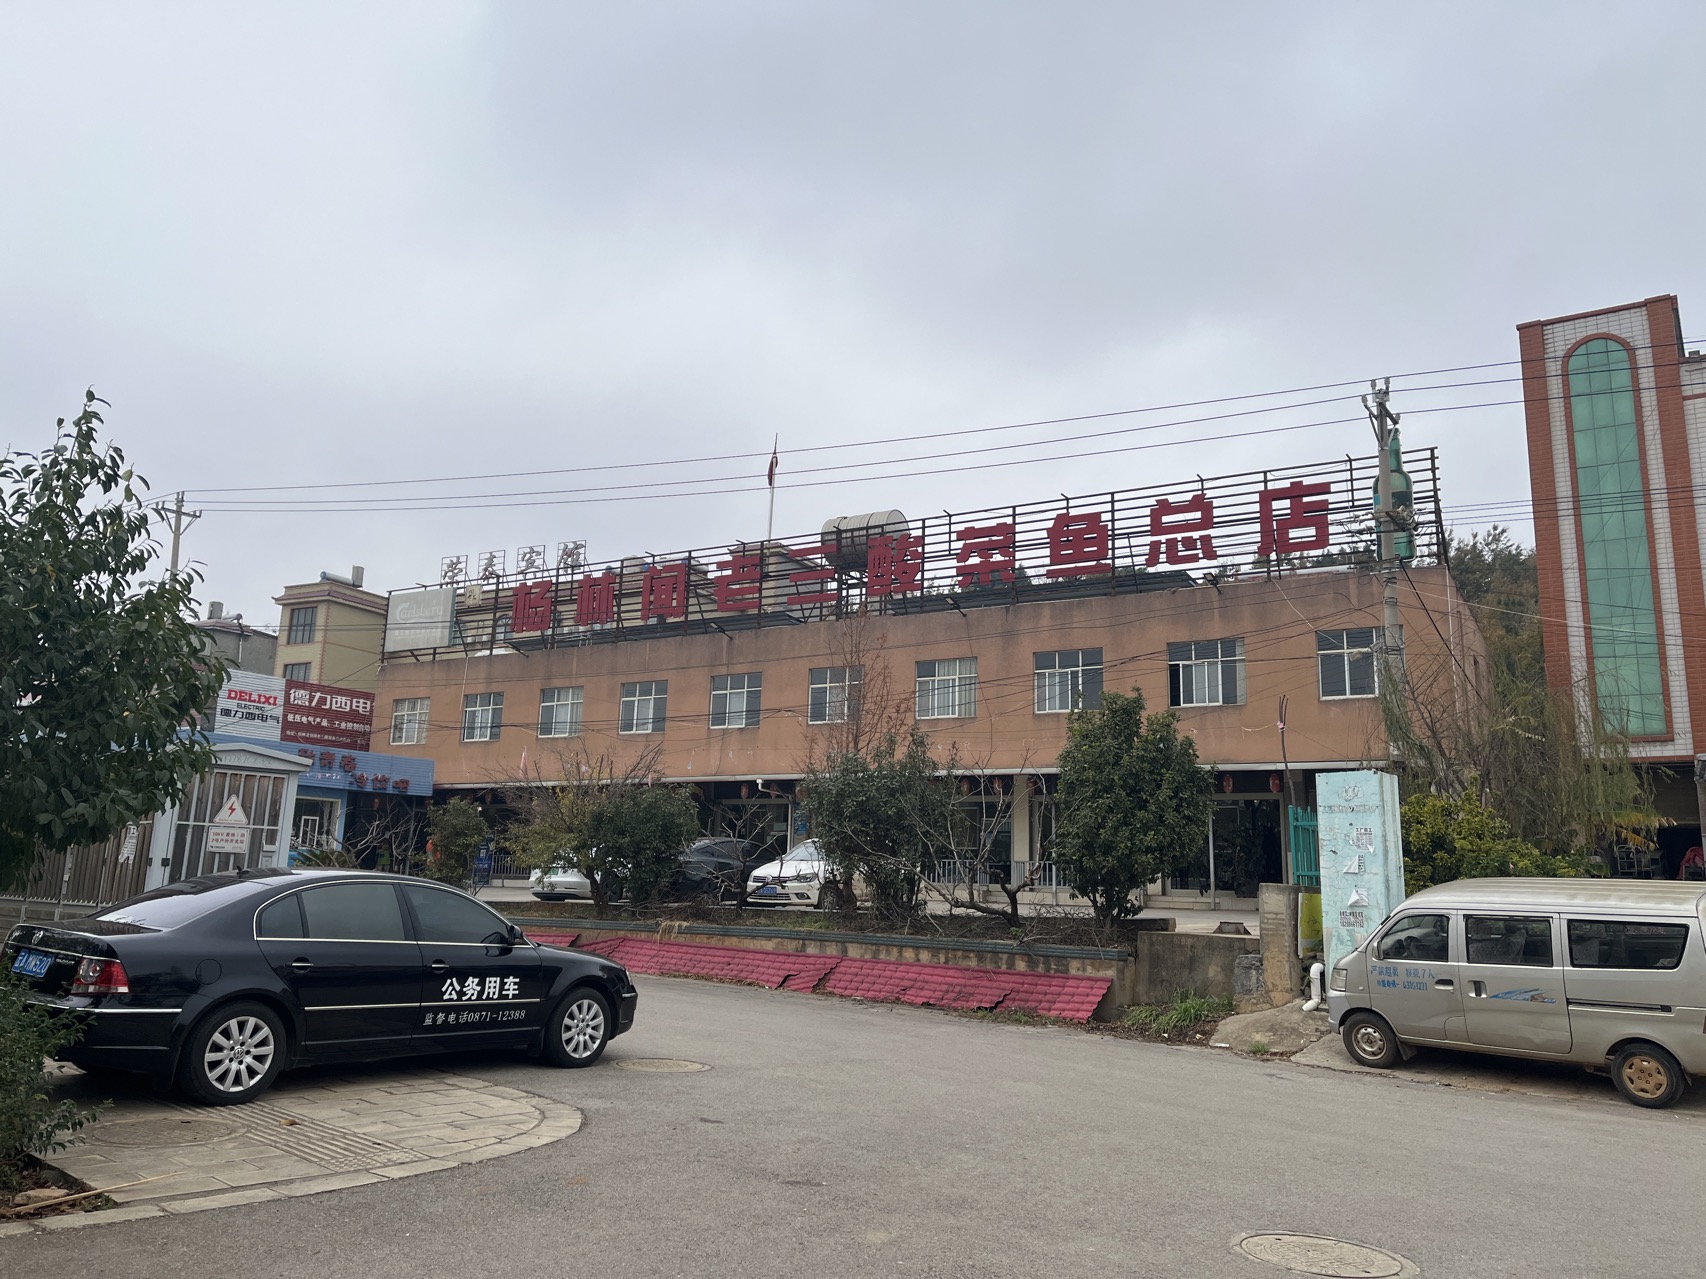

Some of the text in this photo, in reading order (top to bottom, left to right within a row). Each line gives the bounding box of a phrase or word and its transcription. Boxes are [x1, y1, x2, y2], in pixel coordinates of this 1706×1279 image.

[442, 541, 585, 587] 荣泰宾馆
[510, 481, 1331, 633] 杨林闻老三酸菜鱼总店
[227, 689, 278, 706] DELIXI
[236, 702, 266, 712] ELECTRIC
[220, 708, 280, 724] 德力西电气
[1370, 965, 1399, 977] 严禁超员
[441, 976, 520, 1000] 公务用车
[423, 1010, 526, 1026] 监督电话0871-12388
